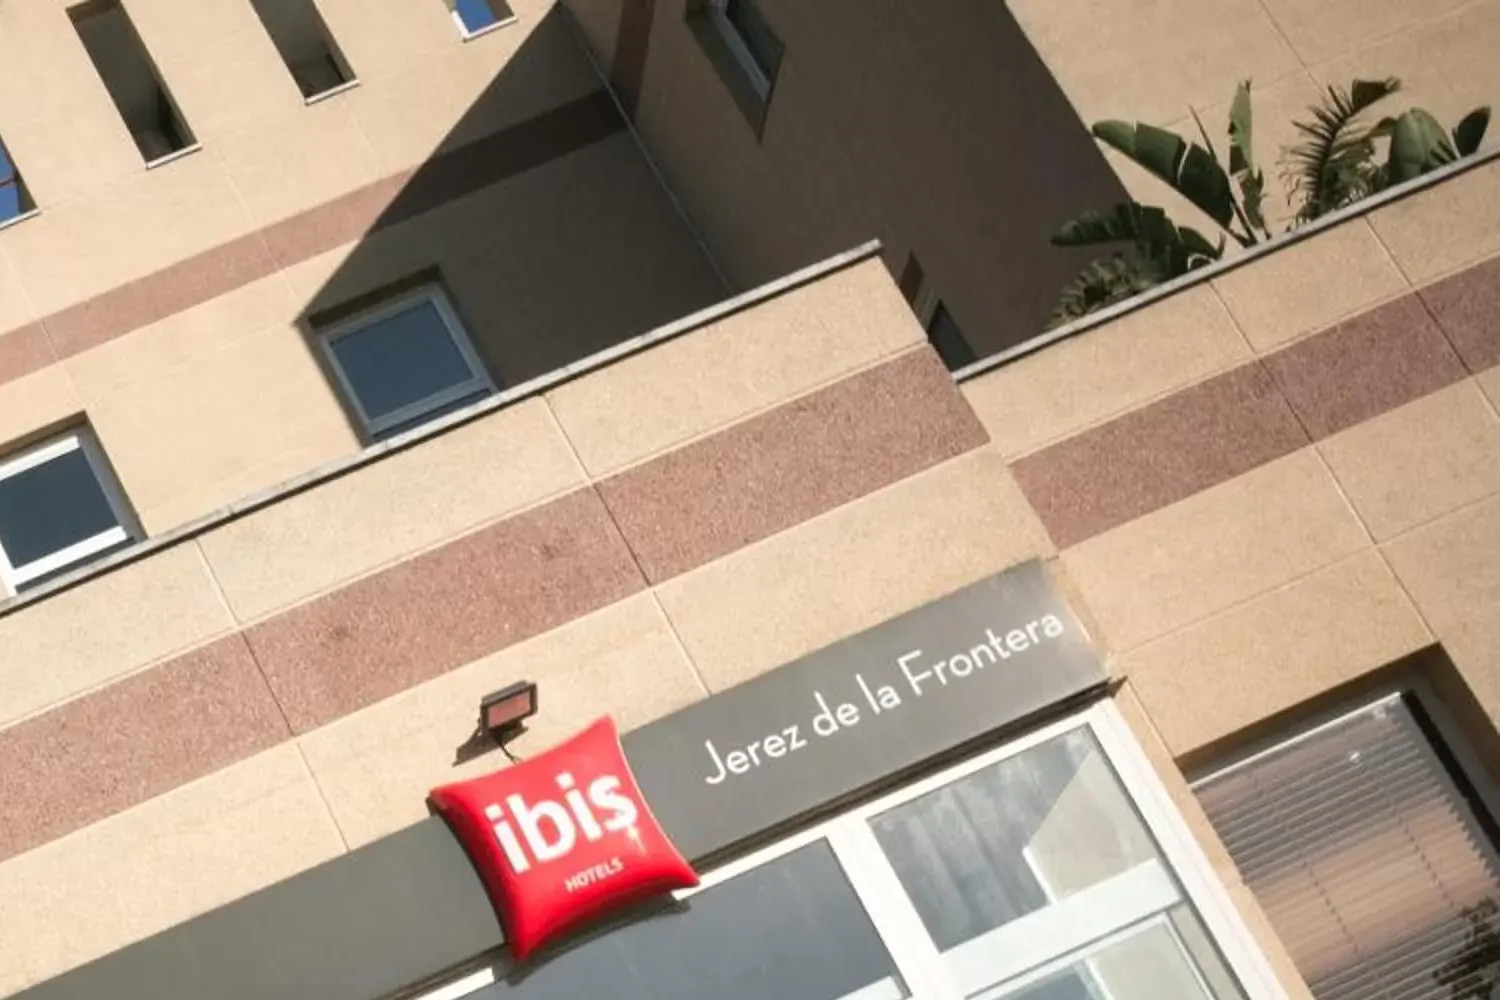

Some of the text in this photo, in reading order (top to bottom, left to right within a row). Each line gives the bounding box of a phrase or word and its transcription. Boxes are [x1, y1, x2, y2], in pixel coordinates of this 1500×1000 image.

[704, 613, 1066, 785] Jerez de la Frontera
[484, 771, 638, 875] ibis
[564, 856, 624, 892] HOTELS
